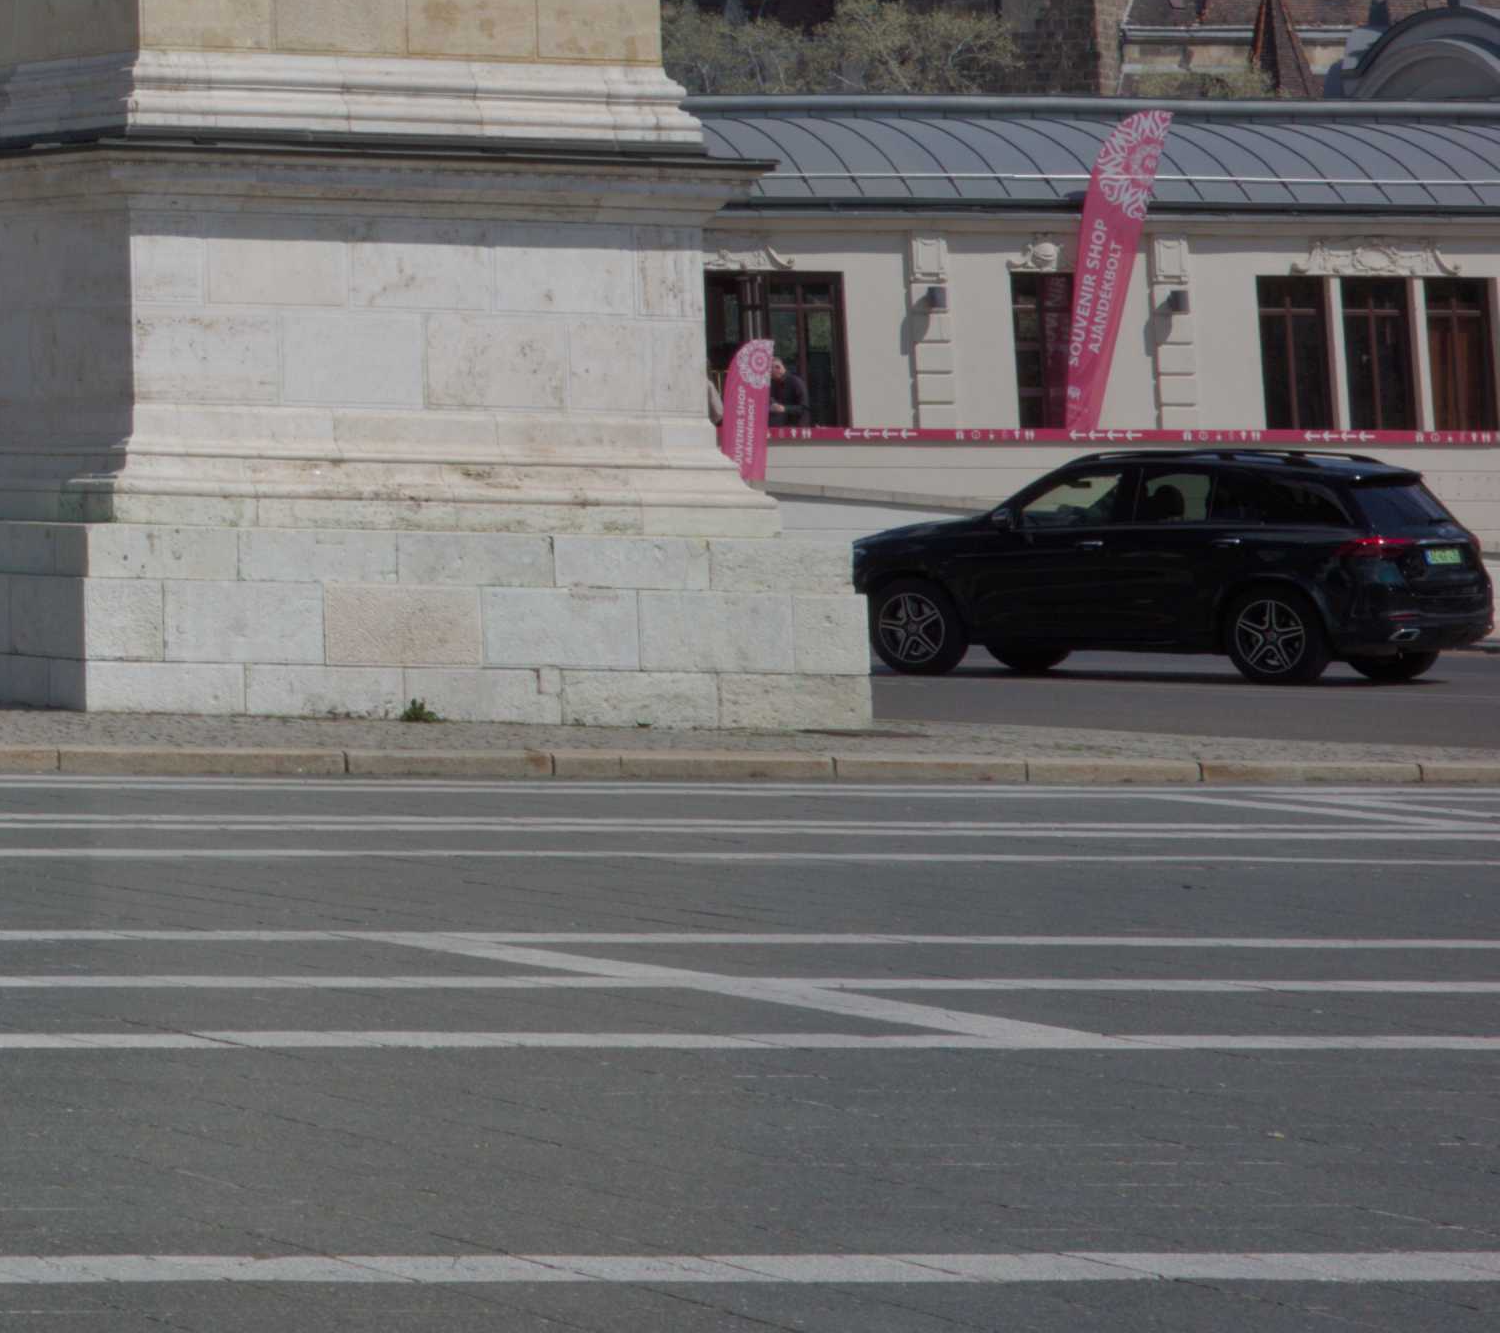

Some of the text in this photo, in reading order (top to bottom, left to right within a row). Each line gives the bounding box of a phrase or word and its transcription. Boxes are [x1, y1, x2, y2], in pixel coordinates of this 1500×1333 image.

[1069, 219, 1108, 366] SOUVENIR SHOP
[736, 385, 746, 416] SHOP
